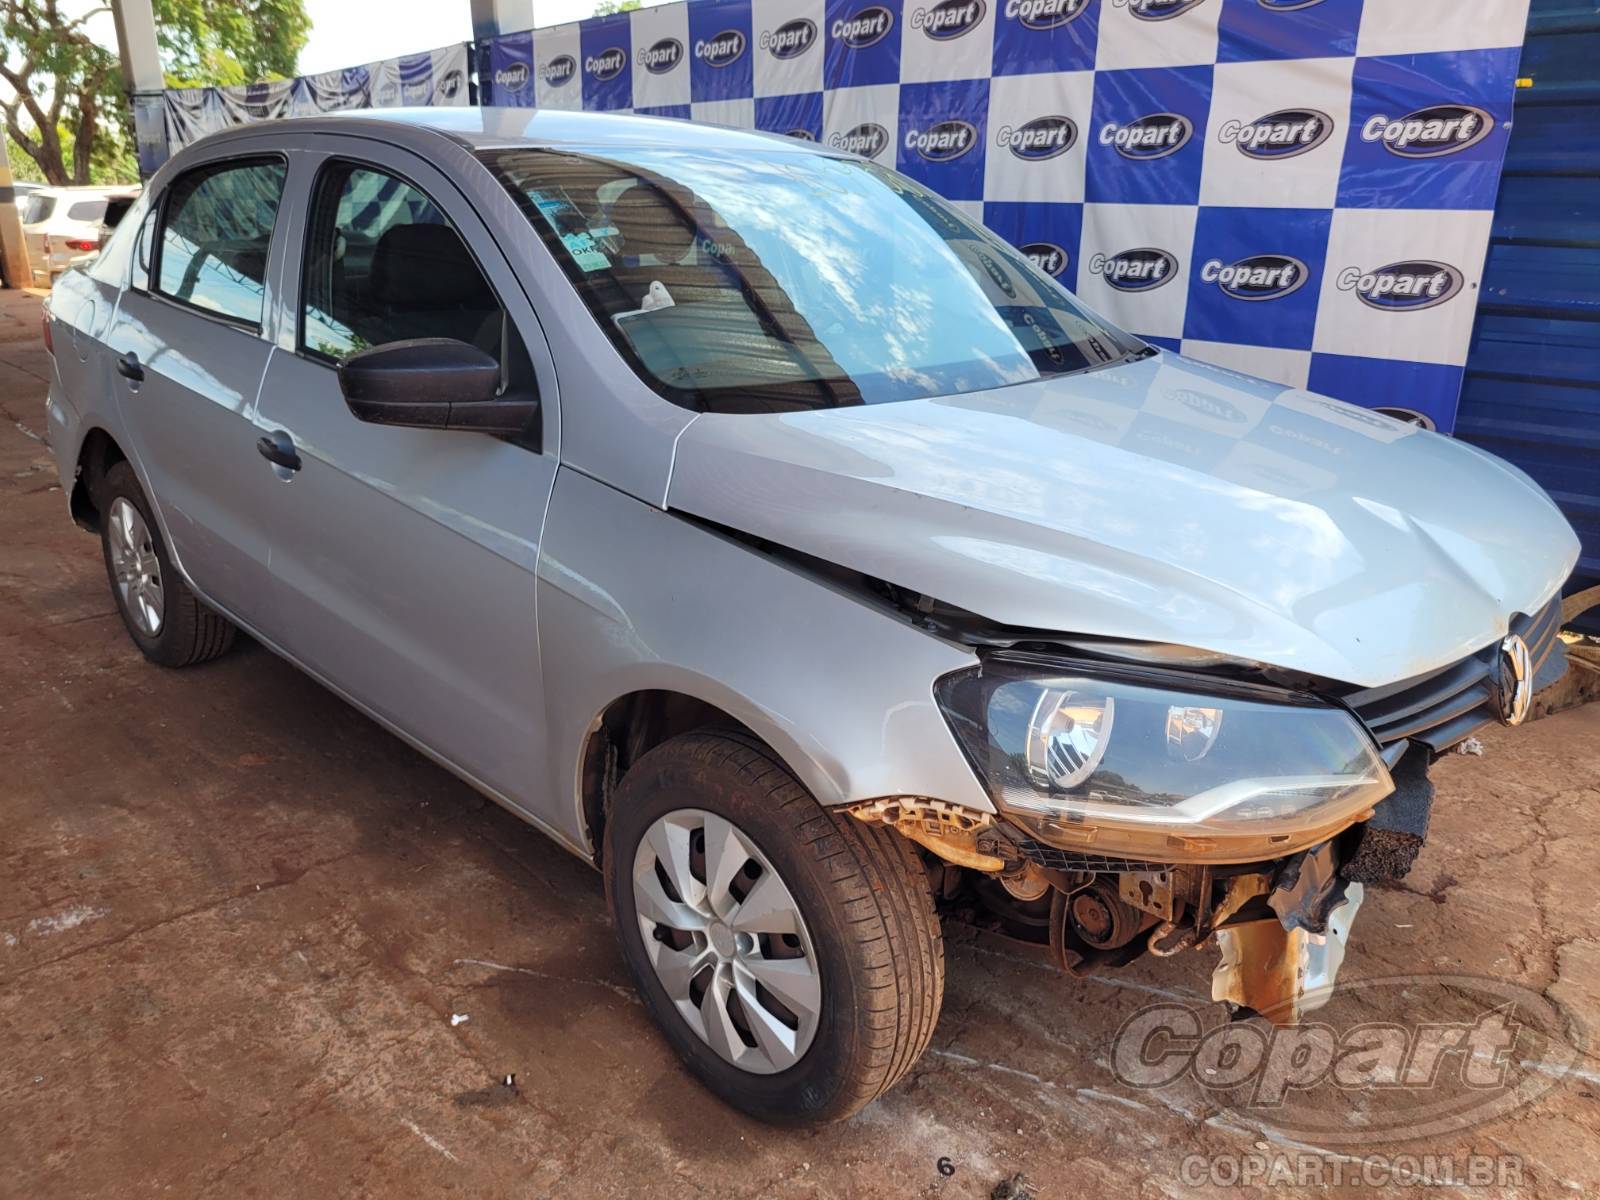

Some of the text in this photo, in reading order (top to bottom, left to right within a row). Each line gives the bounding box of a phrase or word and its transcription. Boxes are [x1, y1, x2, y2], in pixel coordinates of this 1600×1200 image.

[911, 3, 974, 30] Copart
[1004, 0, 1075, 20] Copart
[760, 29, 808, 51] Copart
[831, 16, 883, 41] Copart
[637, 48, 679, 67] Copart
[695, 40, 739, 60] Copart
[585, 53, 622, 74] Copart
[495, 69, 526, 86] Copart
[829, 132, 880, 151] Copart
[905, 128, 967, 151] Copart
[997, 126, 1067, 150] Copart
[1099, 123, 1182, 149] Copart
[1218, 118, 1319, 146] Copart
[1361, 114, 1478, 146] Copart
[702, 239, 736, 257] Copa
[1089, 252, 1165, 280] Copart
[1201, 258, 1297, 288] Copart
[1336, 266, 1450, 298] Copart
